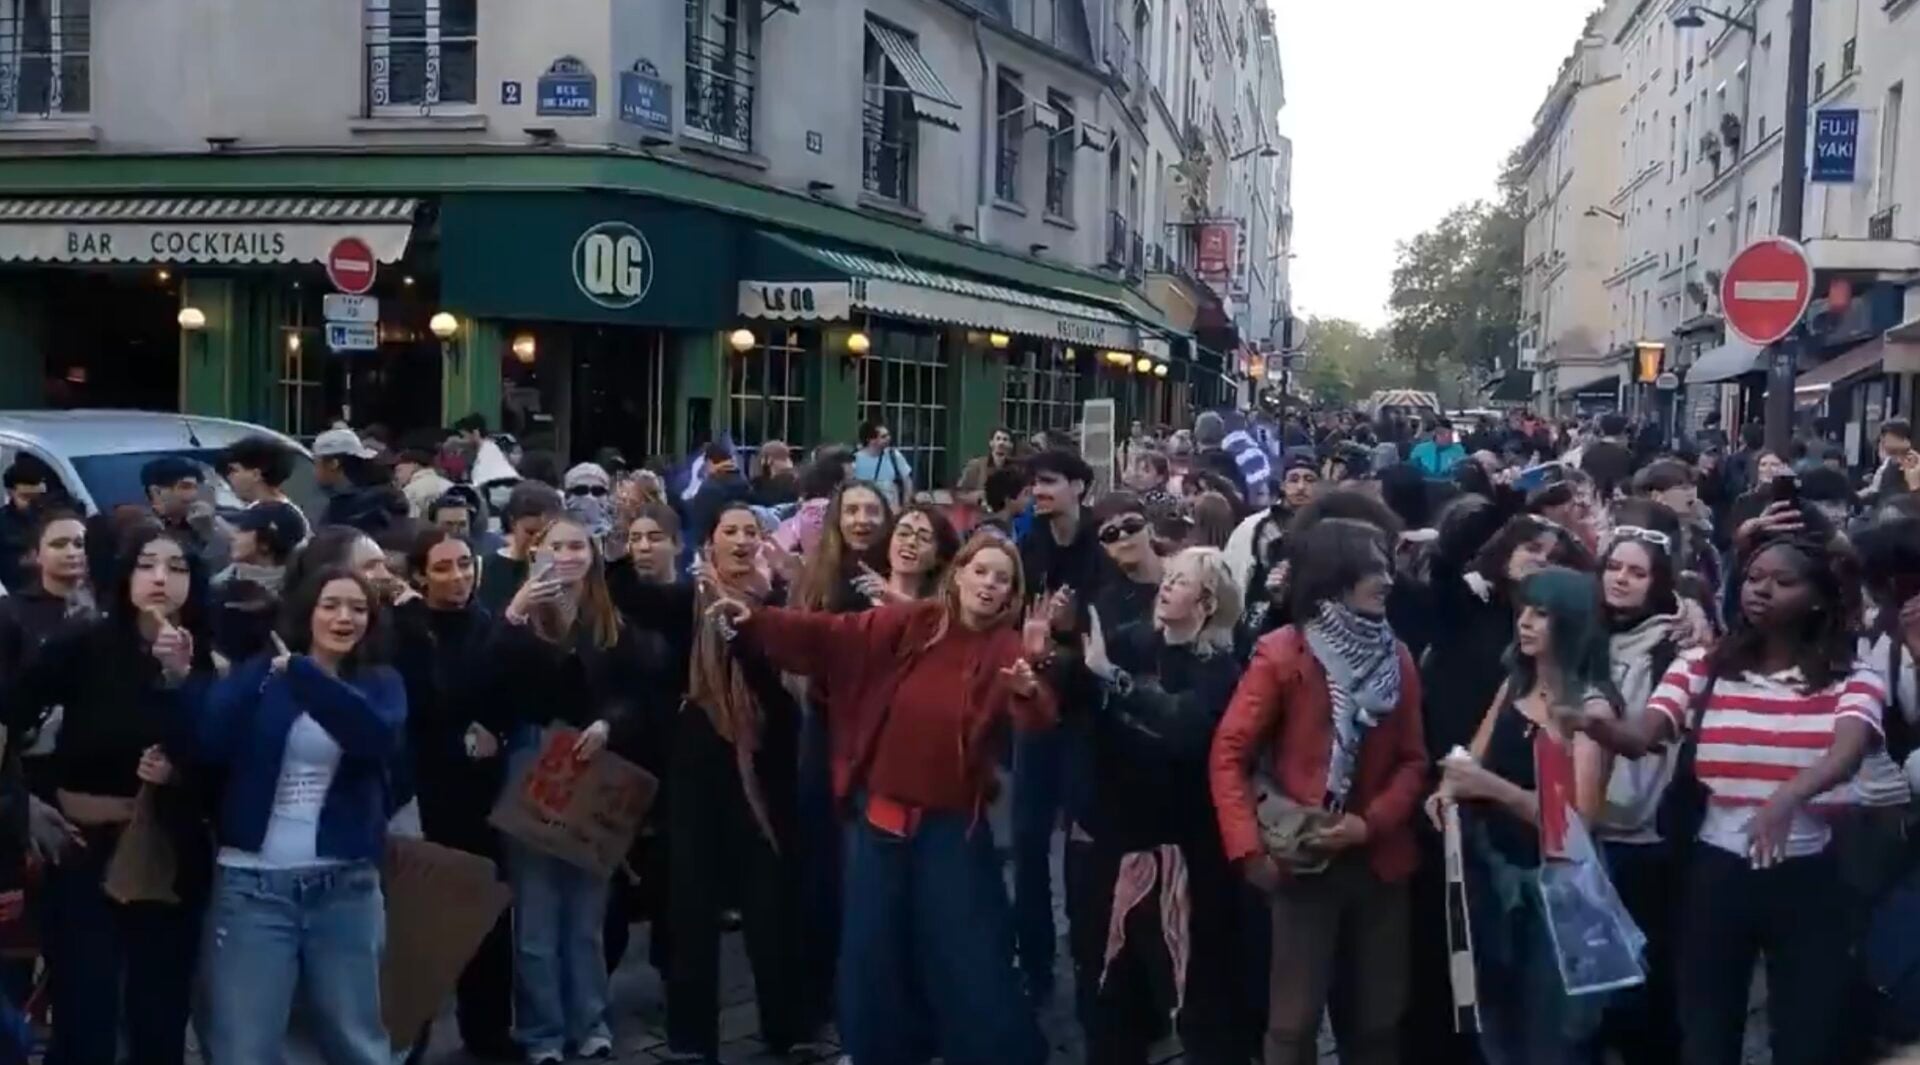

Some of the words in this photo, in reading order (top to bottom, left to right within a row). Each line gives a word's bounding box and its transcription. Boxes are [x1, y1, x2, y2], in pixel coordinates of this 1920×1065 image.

[505, 83, 517, 102] 2
[556, 85, 579, 96] RUE
[1820, 119, 1855, 136] FUJI
[1818, 142, 1853, 157] YAKI
[67, 232, 111, 254] BAR
[151, 232, 285, 255] COCKTAILS
[584, 233, 642, 297] QG
